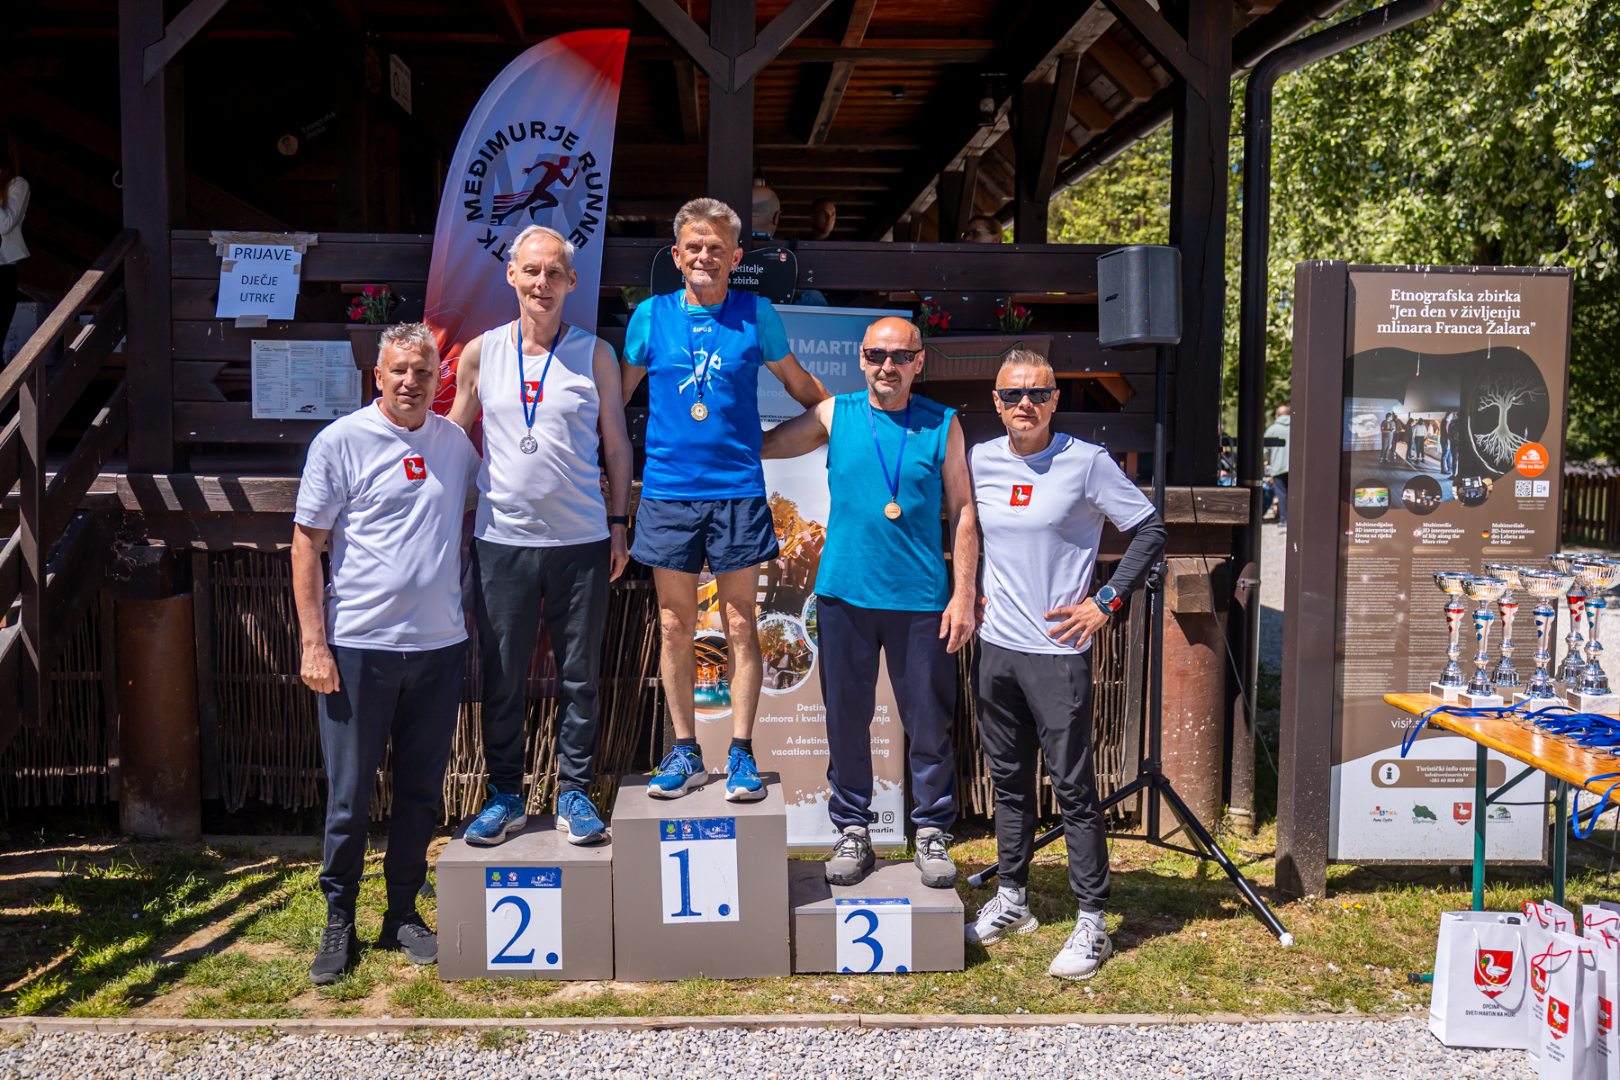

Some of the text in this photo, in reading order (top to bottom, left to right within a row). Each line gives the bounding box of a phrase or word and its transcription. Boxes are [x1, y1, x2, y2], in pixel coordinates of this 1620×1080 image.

[464, 121, 579, 221] MEĐIMURJE
[568, 151, 603, 249] RUNNE
[234, 247, 293, 261] PRIJAVE
[731, 264, 764, 274] jetitelje
[241, 273, 278, 286] DJEČJE
[733, 277, 759, 285] zbirka
[240, 292, 276, 303] UTRKE
[1390, 289, 1521, 305] Etnografska zbirka
[1389, 304, 1521, 321] "Jen den v življenju
[1377, 320, 1536, 335] mlinara Franca Žalara"
[798, 339, 863, 356] MARTI
[797, 703, 827, 712] Destin
[759, 715, 793, 723] odmora
[802, 715, 827, 723] kvalit
[786, 736, 794, 744] A
[795, 736, 829, 745] destina
[771, 748, 811, 756] vacation
[668, 848, 732, 918] 1.
[490, 895, 559, 965] 2.
[842, 909, 908, 973] 3.
